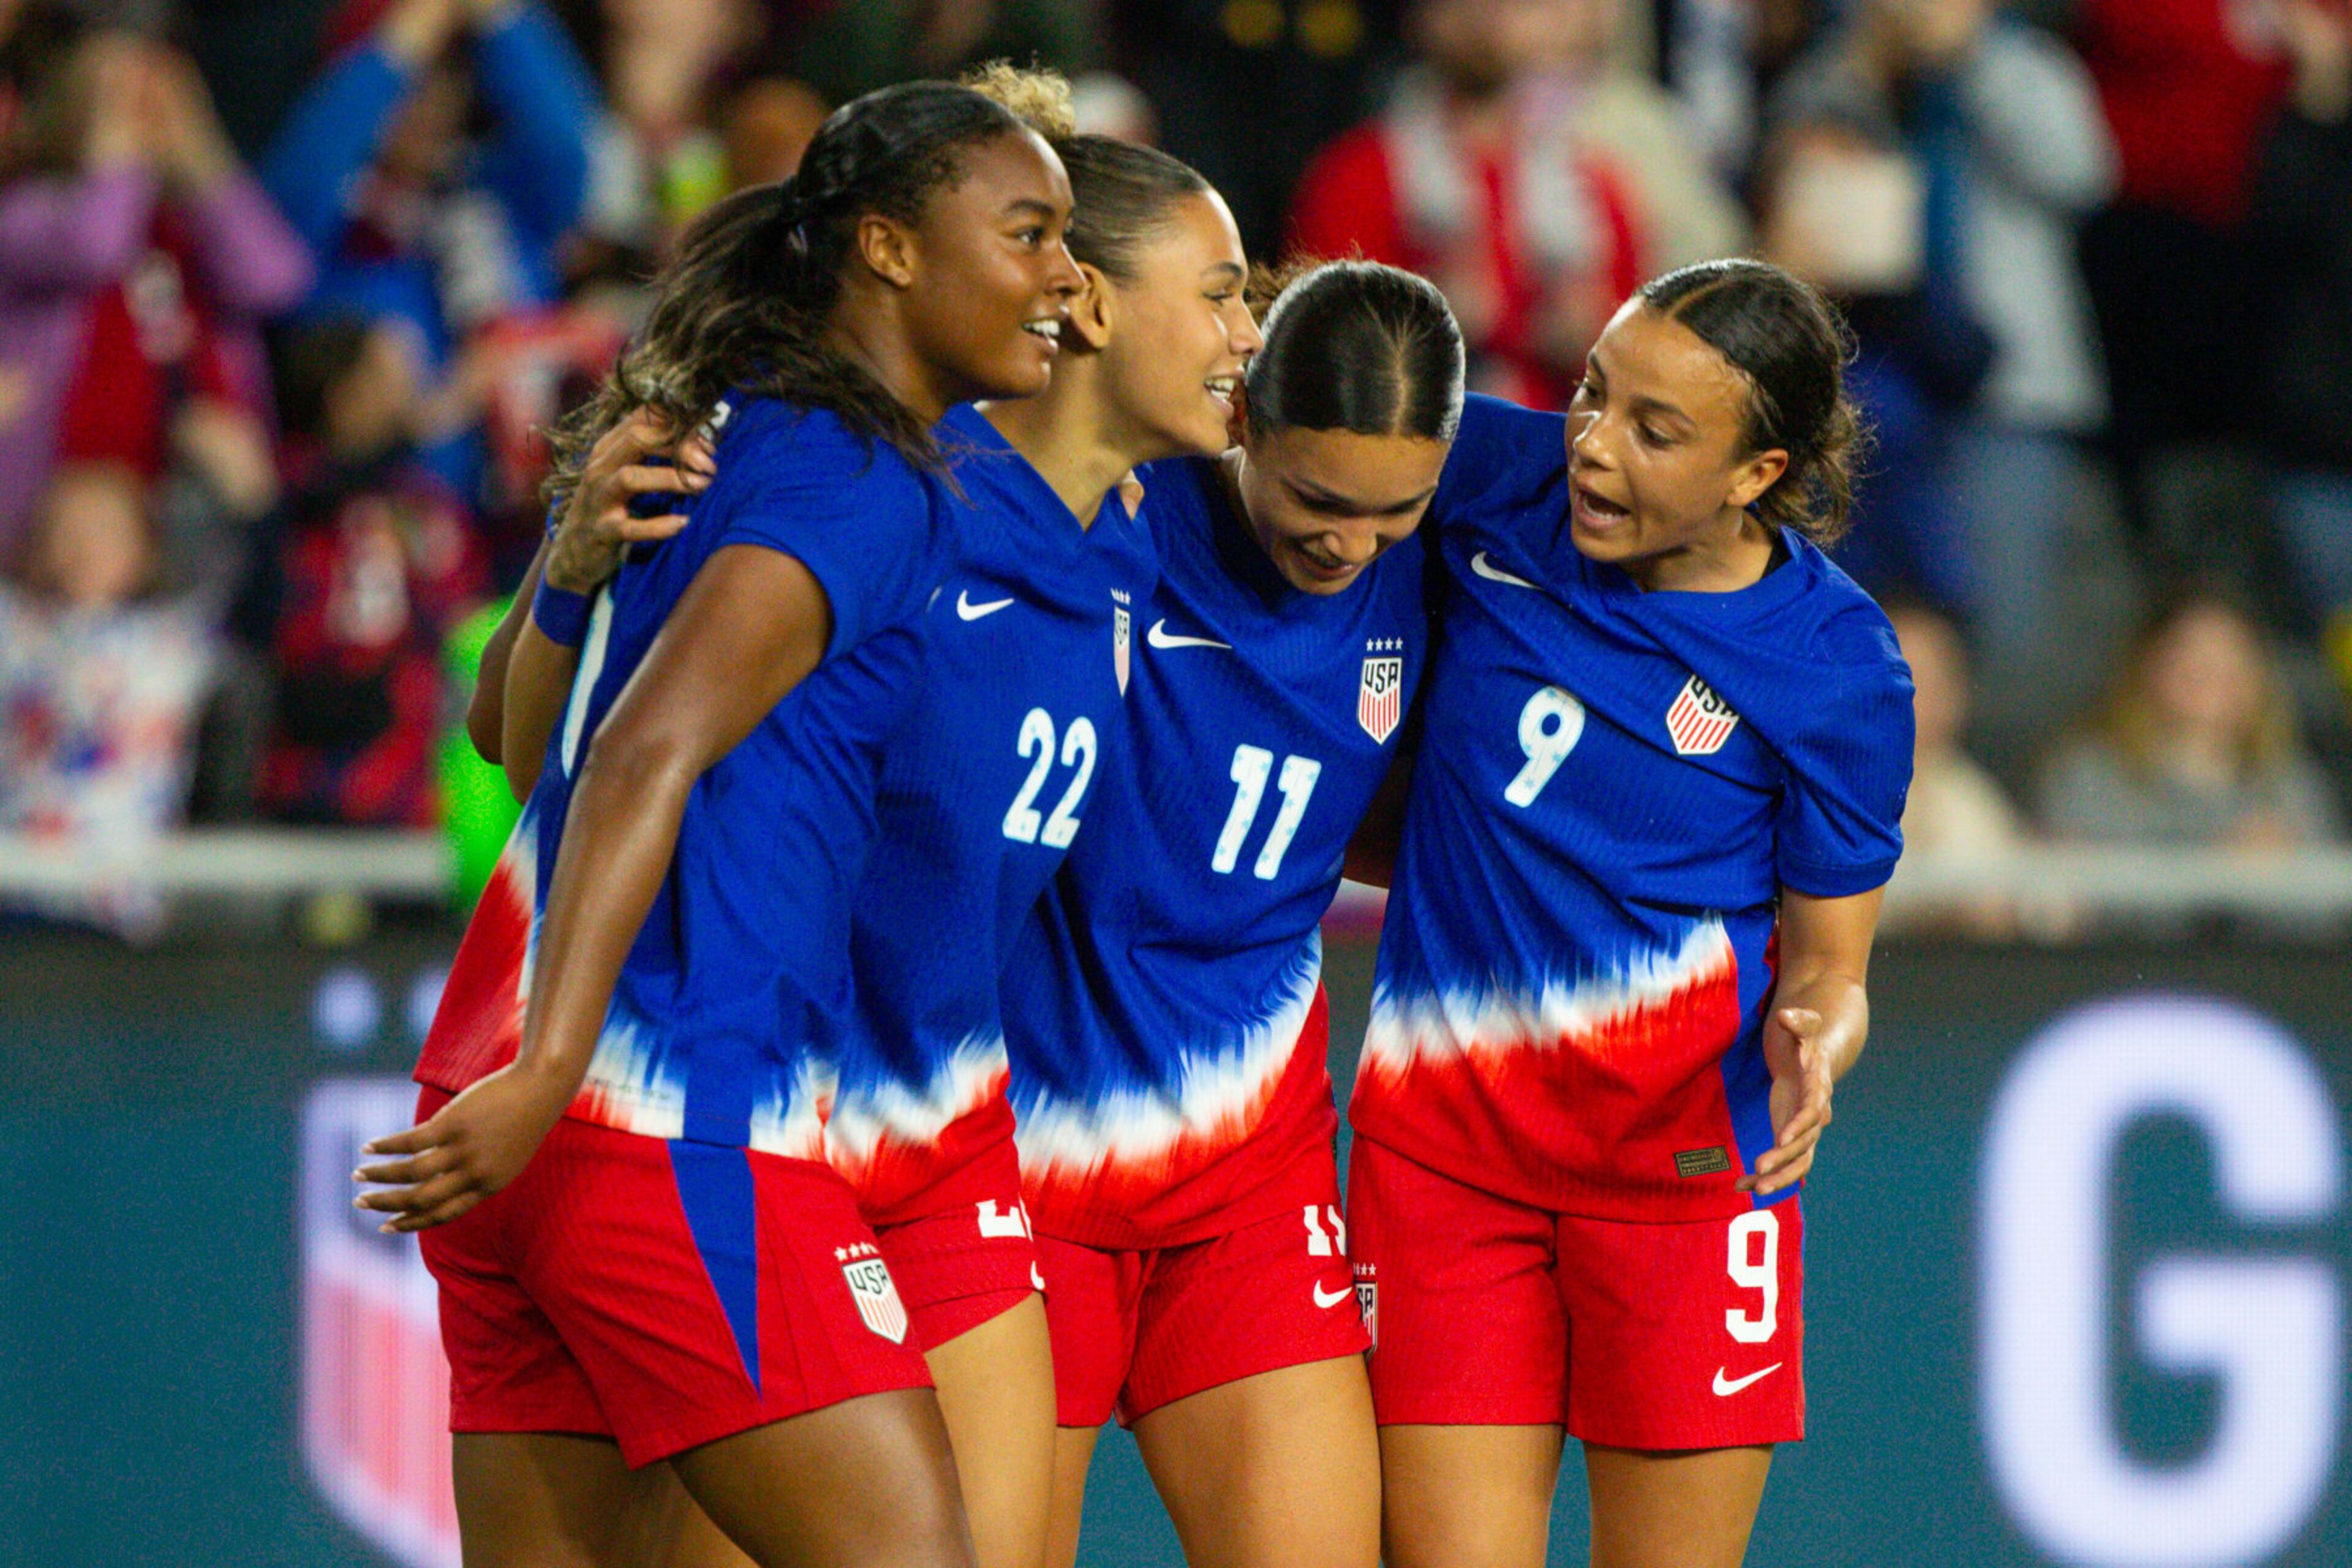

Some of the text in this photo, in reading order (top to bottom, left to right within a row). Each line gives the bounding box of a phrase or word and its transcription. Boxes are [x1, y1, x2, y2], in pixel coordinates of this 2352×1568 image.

[1365, 662, 1398, 694] USA
[1002, 707, 1097, 850] 22
[1211, 743, 1322, 880] 11
[1504, 685, 1585, 808] 9
[849, 1264, 888, 1294] USA
[1725, 1210, 1779, 1343] 9
[1982, 1000, 2341, 1568] G
